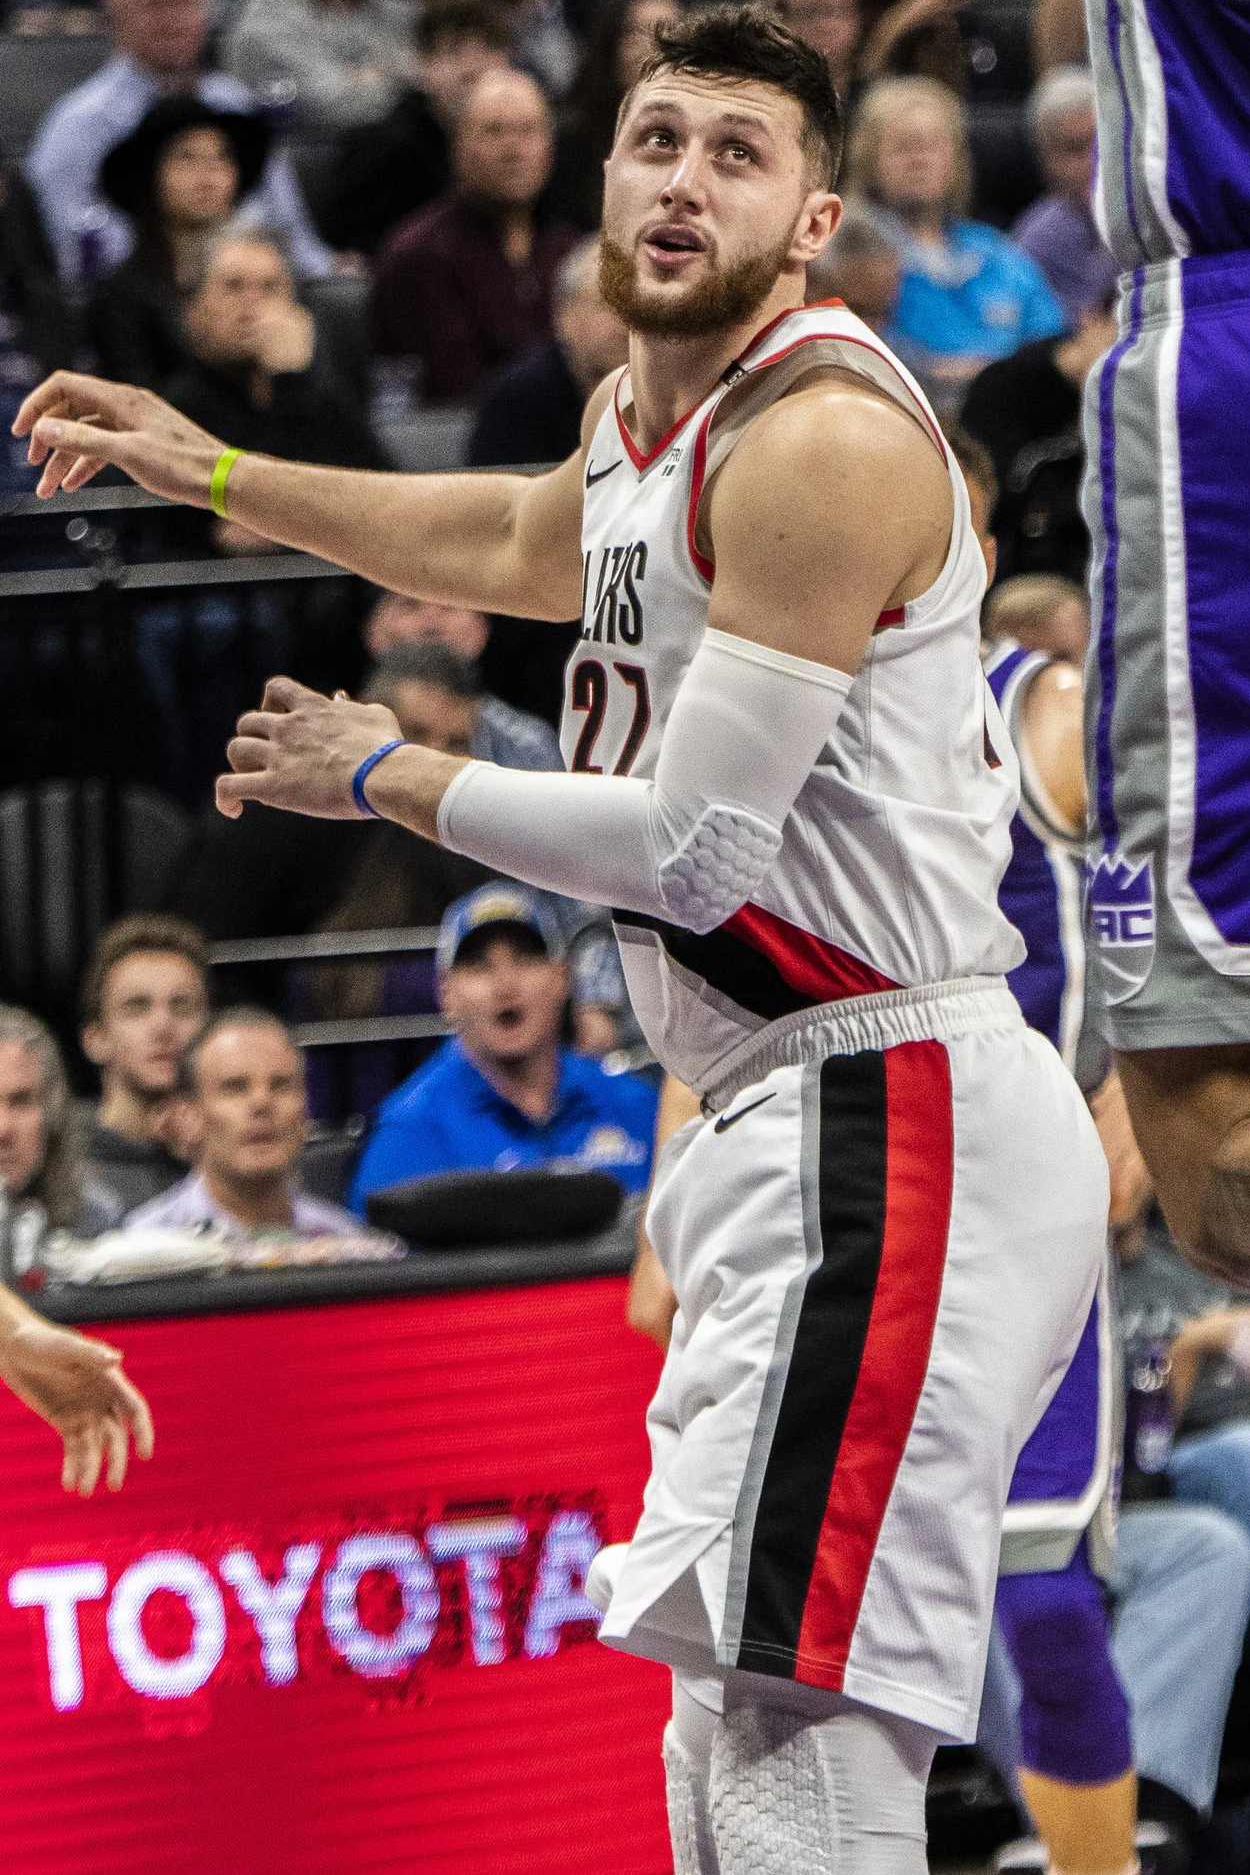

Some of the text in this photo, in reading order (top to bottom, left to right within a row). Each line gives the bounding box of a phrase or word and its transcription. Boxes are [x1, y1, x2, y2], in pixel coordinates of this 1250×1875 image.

[572, 659, 651, 777] 27
[1092, 909, 1153, 942] AC
[8, 1509, 604, 1712] TOYOTA
